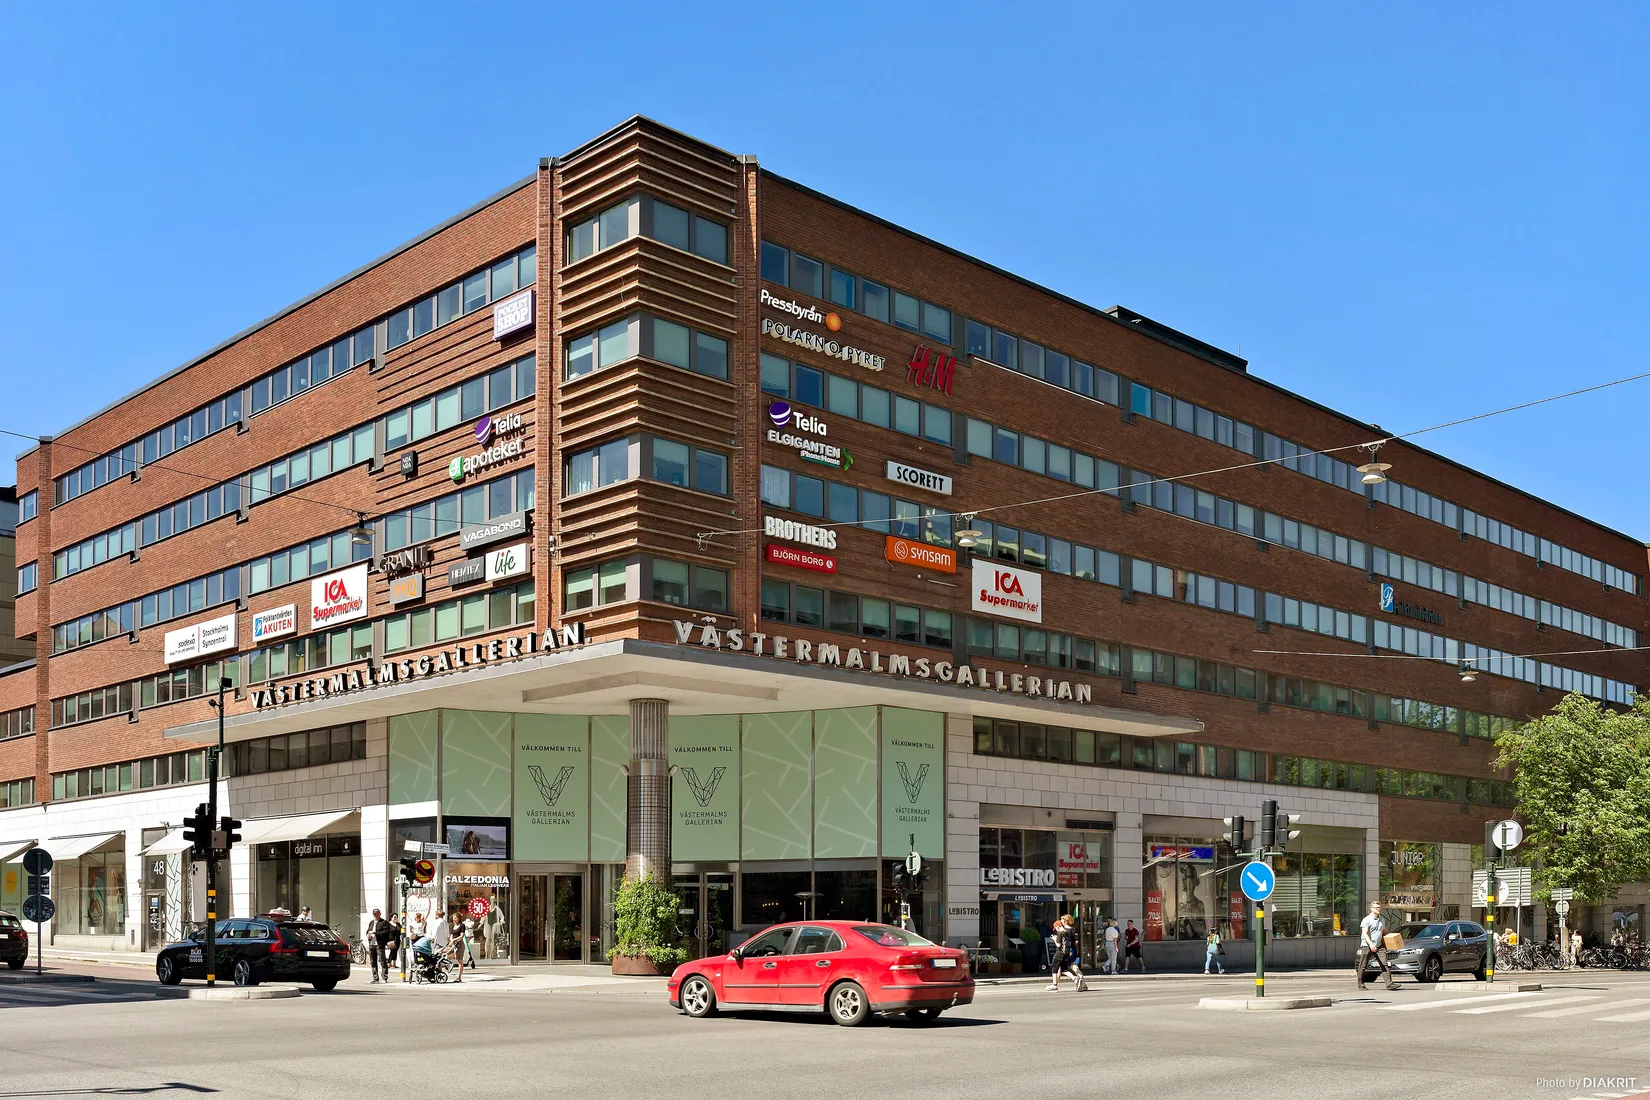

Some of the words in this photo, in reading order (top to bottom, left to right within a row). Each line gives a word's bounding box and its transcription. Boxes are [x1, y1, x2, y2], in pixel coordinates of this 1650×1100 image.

[760, 289, 823, 323] Pressbyrån
[498, 307, 528, 332] SHOP
[762, 318, 825, 352] POLARN
[843, 346, 885, 371] PYRET
[906, 344, 956, 396] H&M
[493, 413, 521, 435] Telia
[793, 411, 827, 436] Telia
[767, 429, 840, 459] ELGIGANTEN
[463, 438, 523, 475] apoteket
[896, 465, 944, 491] SCORETT
[463, 519, 521, 543] VAGABOND
[764, 515, 837, 550] BROTHERS
[379, 545, 427, 572] GRANIT
[494, 550, 516, 575] life
[773, 549, 800, 563] BJÖRN
[801, 555, 824, 567] BORG
[910, 546, 951, 566] SYNSAM
[324, 578, 348, 603] ICA
[393, 579, 417, 599] MQ
[993, 570, 1024, 597] ICA
[313, 598, 361, 621] Supermarket
[979, 589, 1039, 613] Supermarket
[202, 624, 229, 638] Stockholms
[263, 618, 292, 635] AKUTEN
[178, 638, 196, 649] sodexo
[202, 634, 227, 648] Syncentral
[251, 621, 585, 708] VÄSTERMALMSGALLERIAN
[672, 616, 1092, 702] VÄSTERMALMSGALLERIAN
[521, 744, 565, 752] VÄLKOMMEN
[674, 745, 717, 753] VÄLKOMMEN
[891, 739, 923, 748] VÄLKOMMEN
[526, 810, 575, 818] VÄSTERMALMS
[680, 810, 728, 818] VÄSTERMALMS
[895, 807, 931, 815] VÄSTERMALMS
[294, 842, 312, 857] digital
[312, 844, 323, 853] inn
[1069, 844, 1089, 859] ICA
[153, 860, 165, 875] 48
[444, 875, 509, 884] CALZEDONIA
